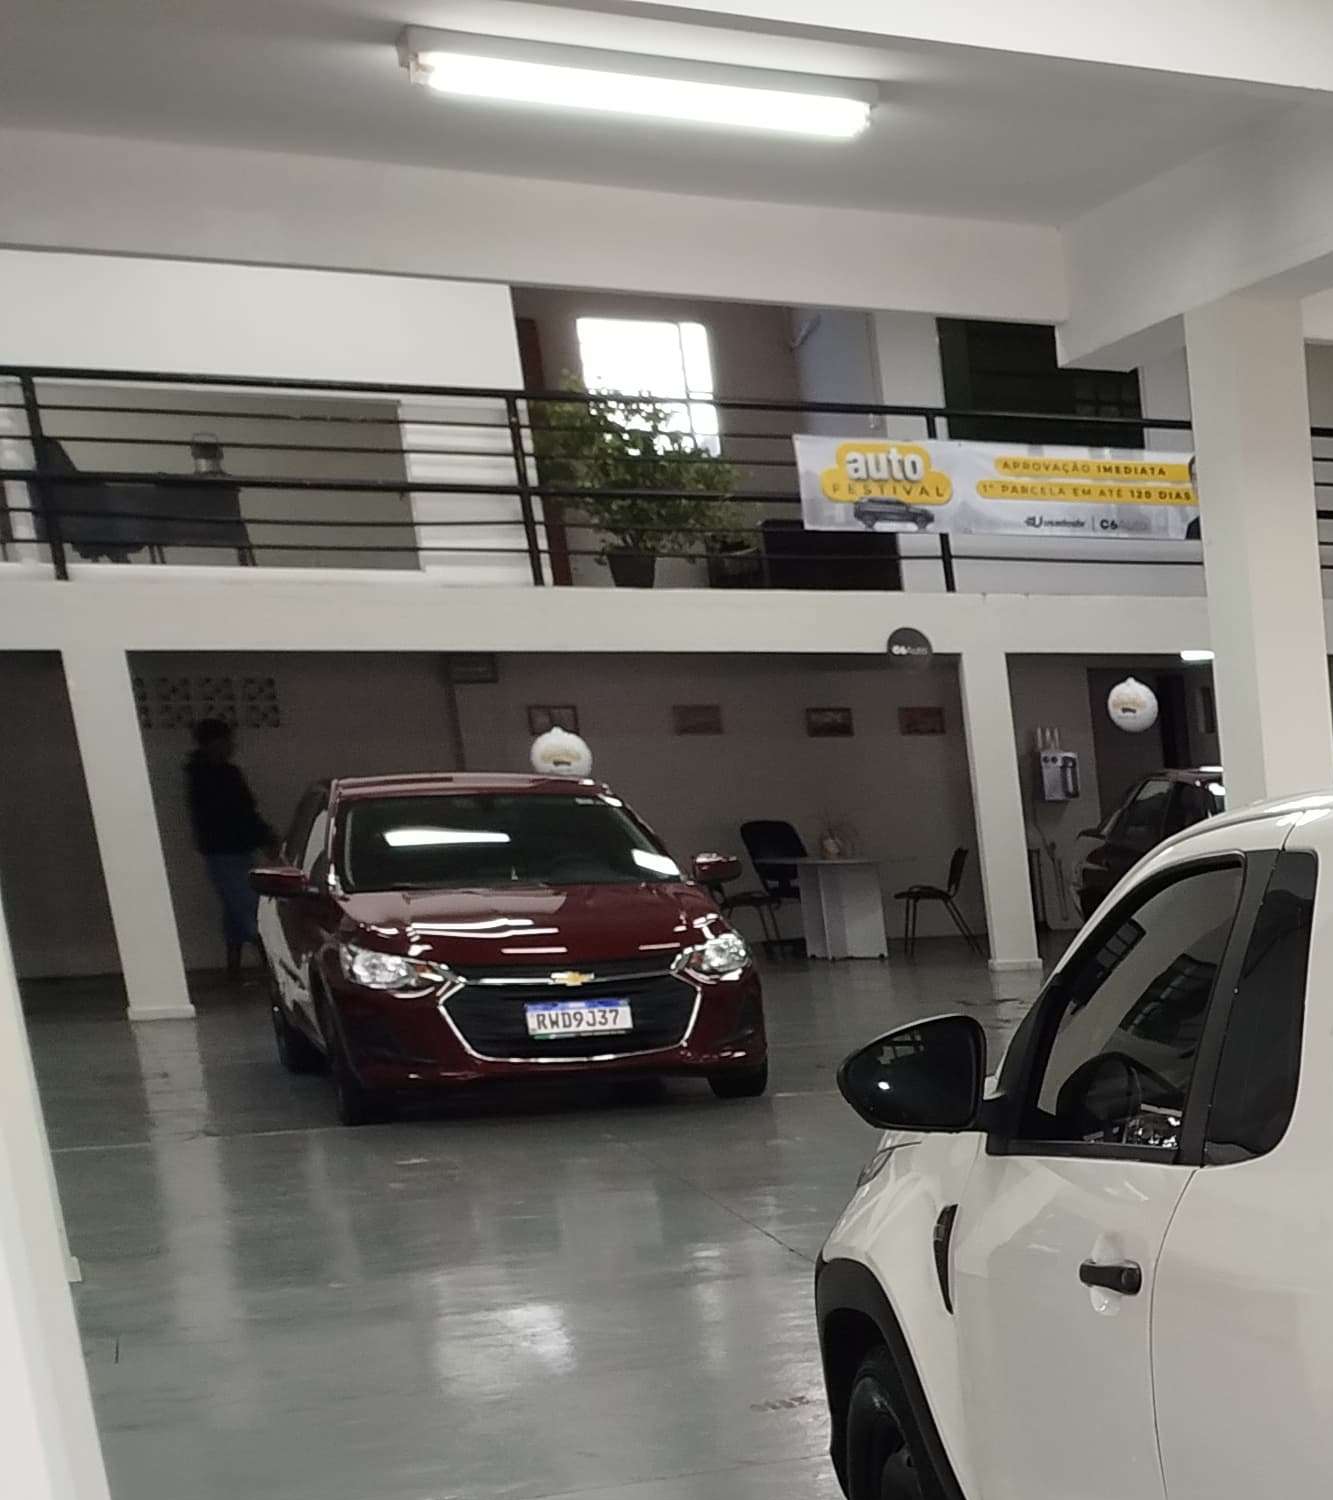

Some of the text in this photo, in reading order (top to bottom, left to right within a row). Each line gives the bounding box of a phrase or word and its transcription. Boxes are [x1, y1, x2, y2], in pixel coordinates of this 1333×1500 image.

[847, 447, 924, 481] auto
[1002, 460, 1166, 476] APROVAÇÃO IMEDIATA
[832, 483, 945, 497] FESTIVAL
[1001, 485, 1067, 497] PARCELA
[1073, 487, 1091, 497] EM
[1158, 491, 1191, 501] DIAS
[536, 1009, 619, 1030] RWD9J37
